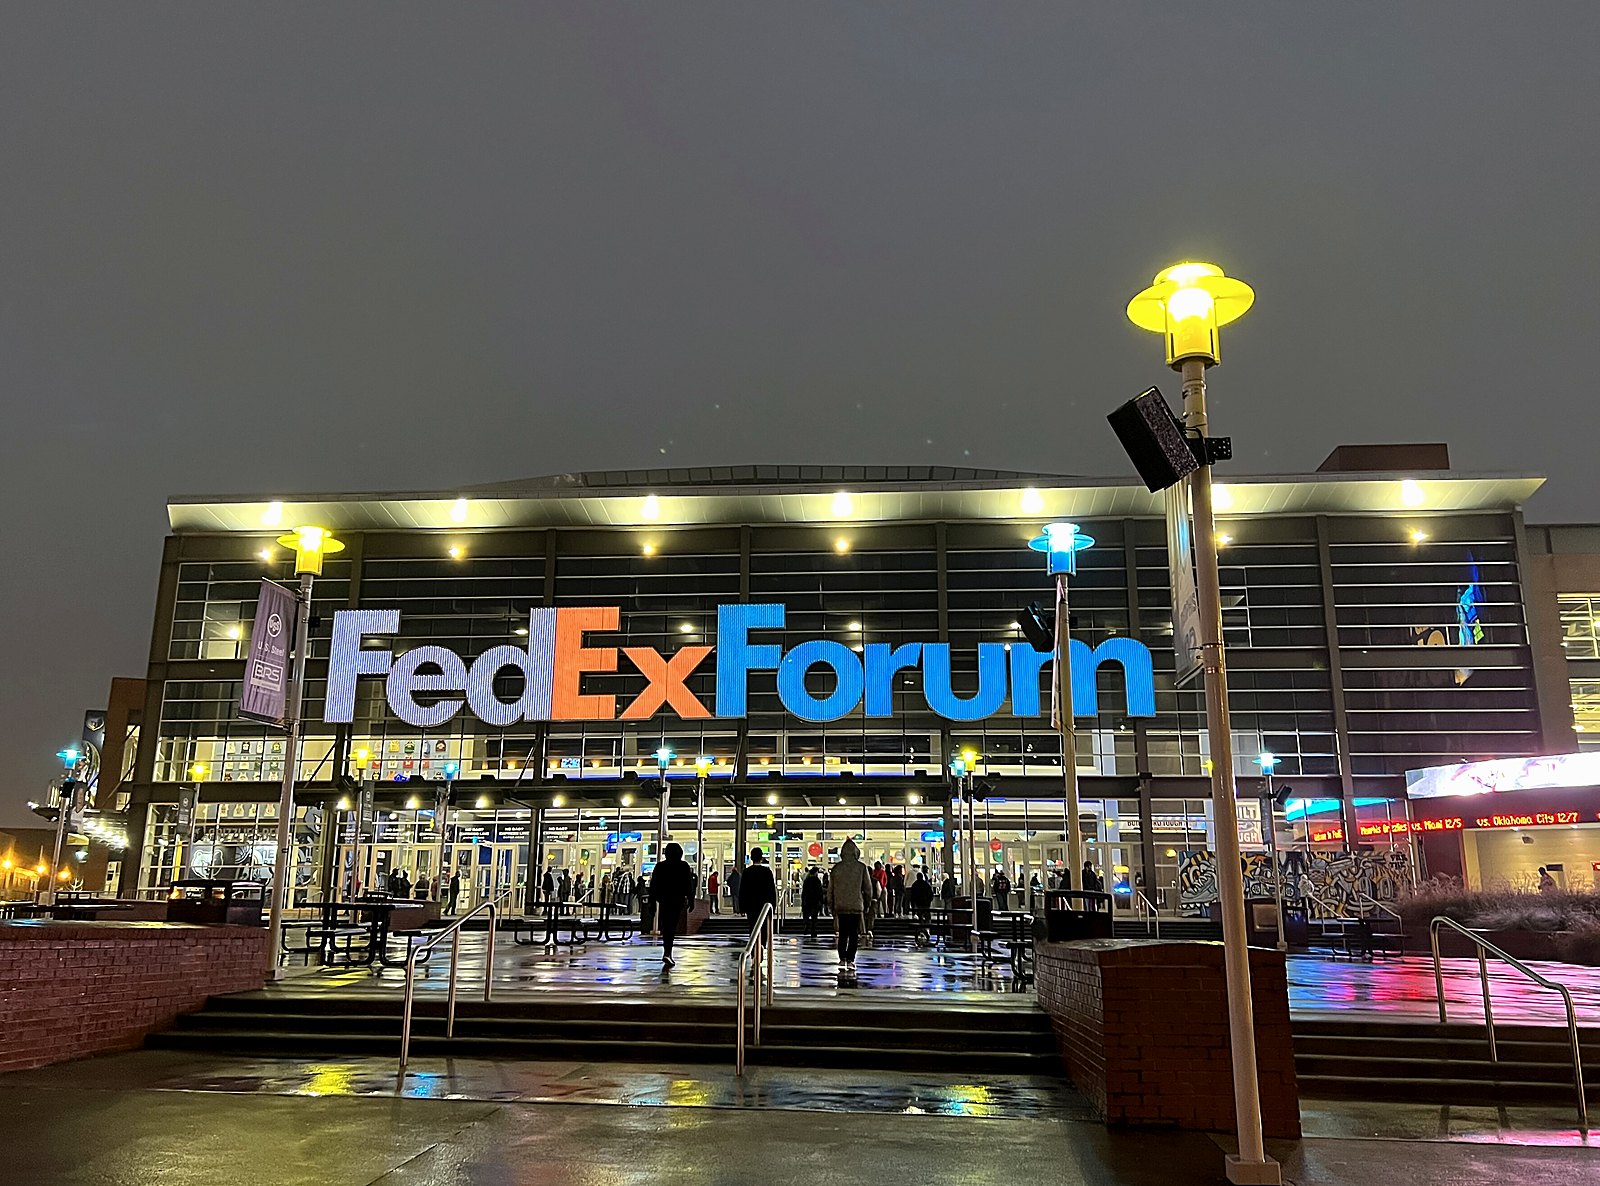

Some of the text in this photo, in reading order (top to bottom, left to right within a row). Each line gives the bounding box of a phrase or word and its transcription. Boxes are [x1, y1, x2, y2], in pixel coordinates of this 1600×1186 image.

[324, 603, 1156, 726] FedExForum
[255, 664, 279, 682] BRS
[1411, 822, 1422, 831] vs.
[1445, 818, 1462, 829] 12/5
[1476, 812, 1578, 827] vs. Oklahoma City 12/7
